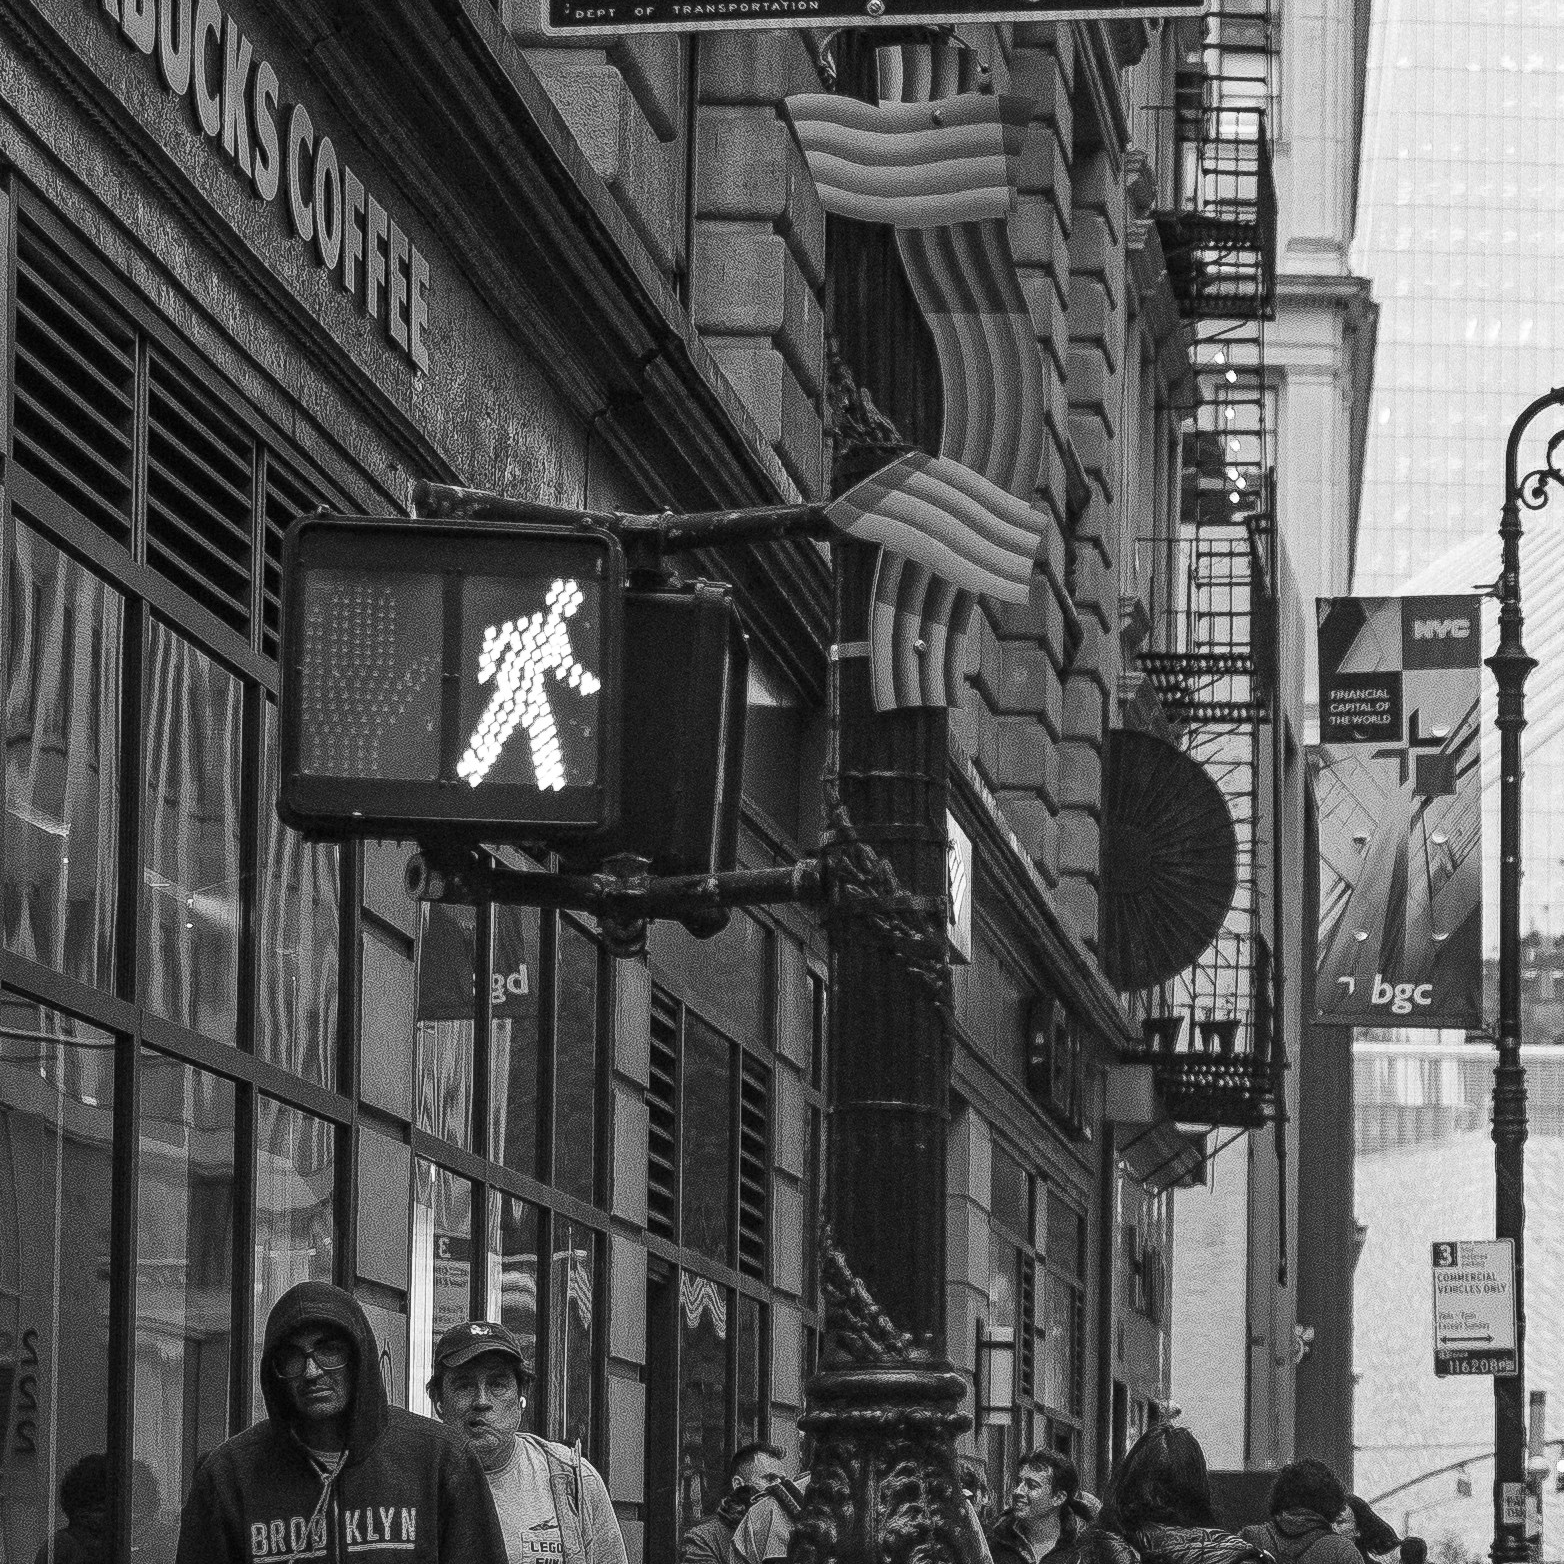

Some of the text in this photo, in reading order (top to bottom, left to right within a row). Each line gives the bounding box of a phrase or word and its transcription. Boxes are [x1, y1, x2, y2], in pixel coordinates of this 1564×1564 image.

[575, 0, 819, 19] DEPT OF TRANSPORTATION
[286, 104, 430, 376] COFFEE
[1413, 618, 1471, 640] NYC
[1330, 688, 1389, 700] FINANCIAL
[1330, 701, 1391, 713] CAPITAL OF
[1330, 713, 1391, 726] THE WORLD
[1371, 973, 1433, 1014] bgc
[1439, 1243, 1453, 1266] 3
[1437, 1272, 1497, 1282] COMMERCIAL
[1438, 1283, 1507, 1294] VEHICLES ONLY
